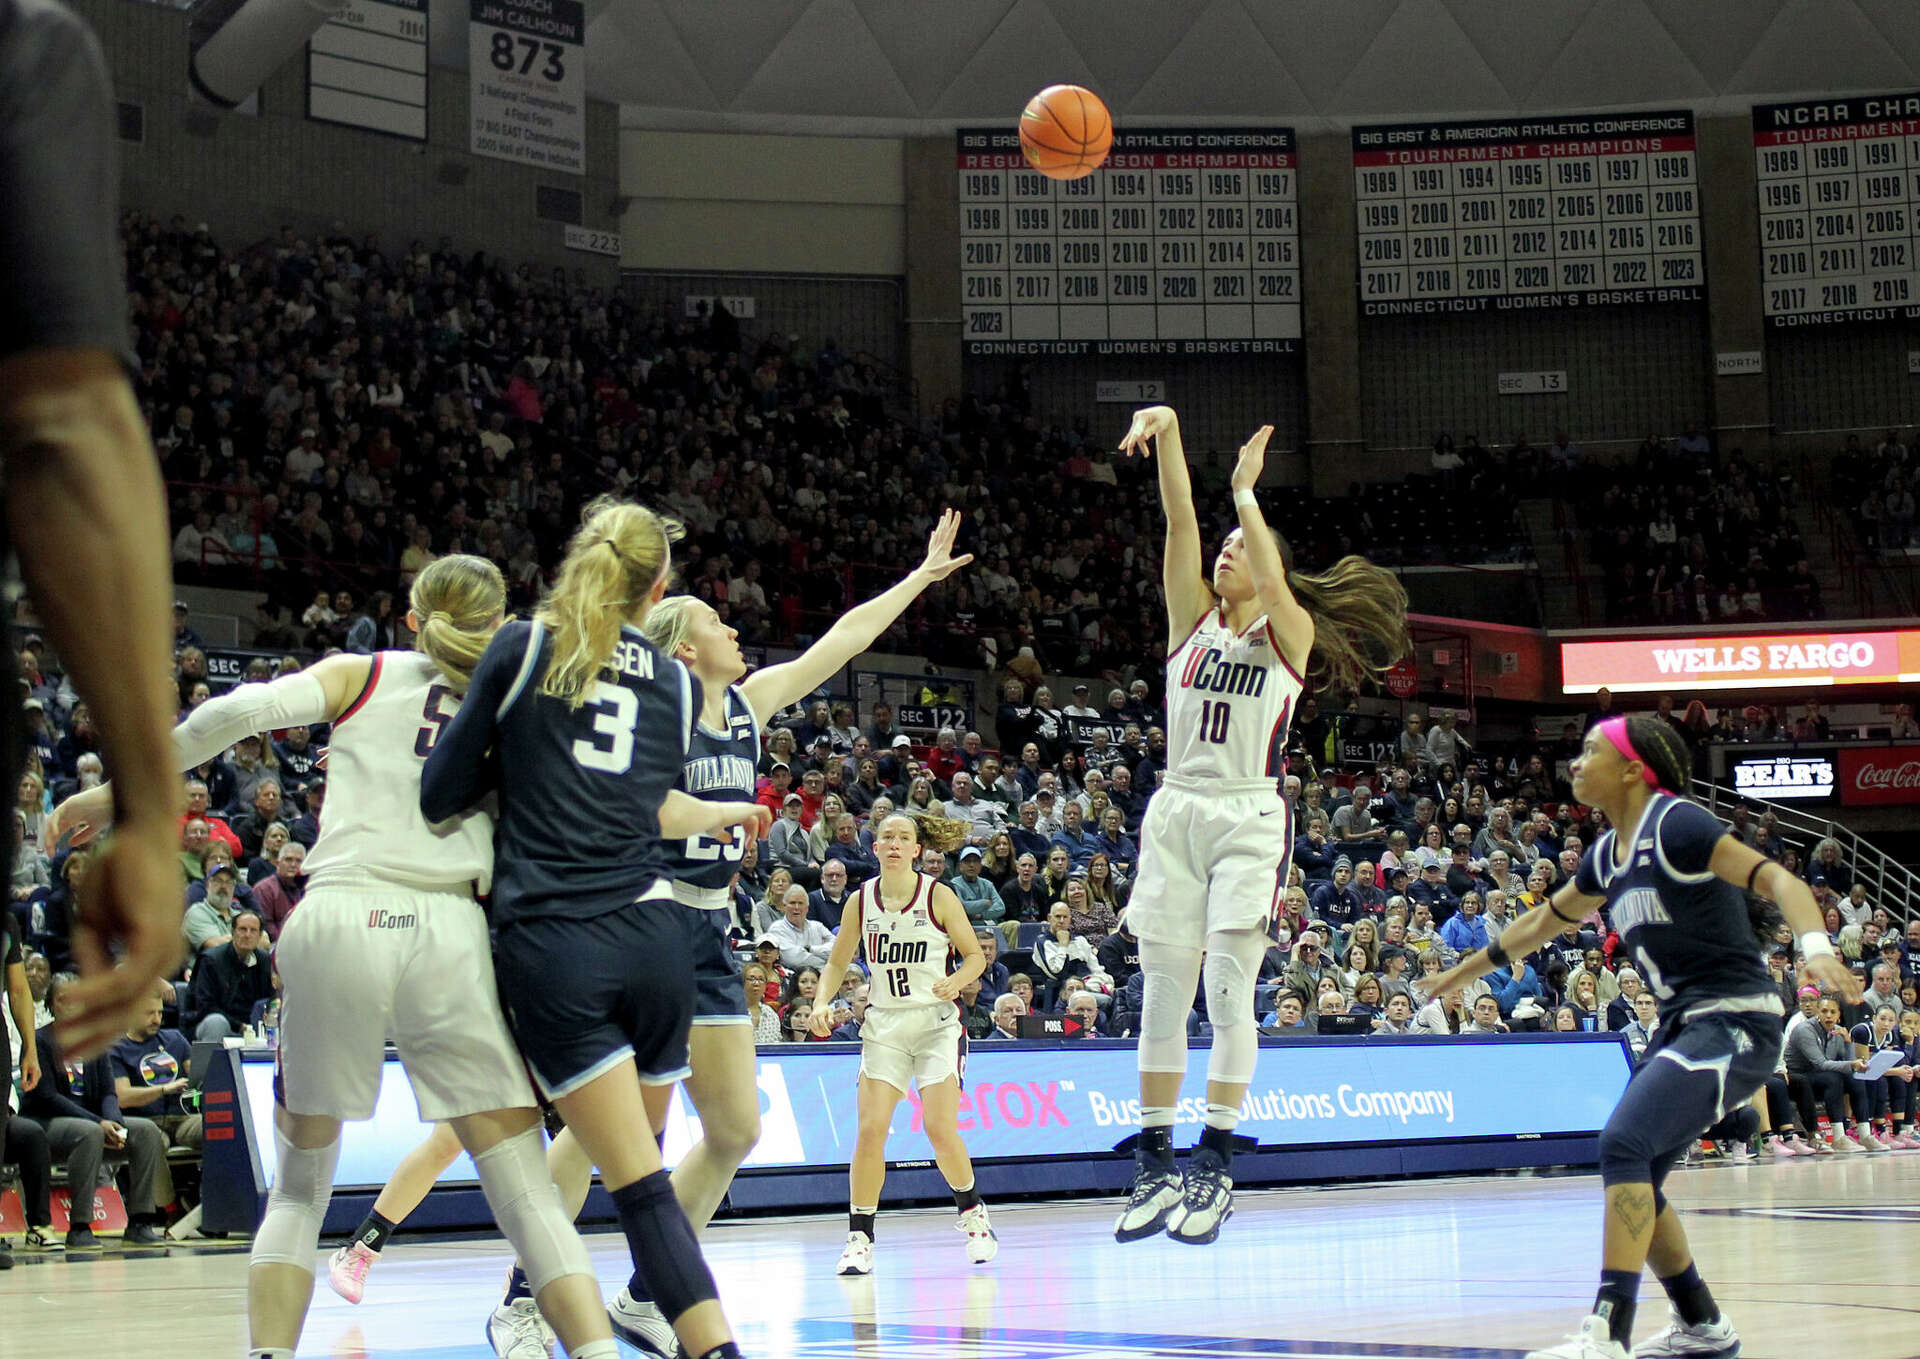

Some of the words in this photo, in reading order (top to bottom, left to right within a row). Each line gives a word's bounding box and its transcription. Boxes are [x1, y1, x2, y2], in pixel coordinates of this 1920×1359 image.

[481, 4, 504, 21] JIM
[507, 11, 576, 38] CALHOUN
[490, 31, 565, 82] 873
[1774, 105, 1849, 125] NCAA
[964, 136, 989, 147] BIG
[1126, 135, 1193, 147] ATHLETIC
[1197, 135, 1287, 147] CONFERENCE
[1360, 132, 1383, 145] BIG
[1388, 130, 1424, 143] EAST
[1431, 128, 1441, 141] &
[1446, 125, 1518, 140] AMERICAN
[1523, 122, 1590, 138] ATHLETIC
[1594, 117, 1686, 134] CONFERENCE
[1773, 121, 1918, 143] TOURNAMENT
[1167, 155, 1289, 167] CHAMPIONS
[1387, 145, 1527, 164] TOURNAMENT
[1540, 139, 1662, 157] CHAMPIONS
[1764, 151, 1799, 173] 1989
[1814, 146, 1849, 168] 1990
[1865, 143, 1897, 165] 1991
[966, 175, 1000, 196] 1989
[1015, 175, 1048, 196] 1990
[1065, 175, 1096, 196] 1991
[1112, 174, 1145, 195] 1994
[1160, 174, 1193, 195] 1995
[1208, 174, 1241, 195] 1996
[1256, 174, 1289, 195] 1997
[1362, 171, 1397, 193] 1989
[1412, 169, 1444, 191] 1991
[1459, 167, 1494, 188] 1994
[1508, 164, 1542, 186] 1995
[1557, 162, 1592, 184] 1996
[1606, 160, 1639, 182] 1997
[1654, 157, 1688, 179] 1998
[1766, 184, 1800, 206] 1996
[1816, 181, 1849, 202] 1997
[1866, 176, 1901, 198] 1998
[967, 209, 1000, 230] 1998
[1015, 209, 1049, 230] 1999
[1063, 209, 1099, 230] 2000
[1112, 209, 1146, 229] 2001
[1159, 209, 1196, 229] 2002
[1207, 208, 1244, 229] 2003
[1256, 208, 1292, 229] 2004
[1365, 205, 1398, 227] 1999
[1412, 203, 1448, 224] 2000
[1462, 200, 1497, 222] 2001
[1509, 198, 1545, 219] 2002
[1558, 196, 1594, 218] 2005
[1607, 193, 1644, 215] 2006
[1656, 191, 1693, 213] 2008
[1766, 218, 1804, 241] 2003
[1816, 214, 1854, 237] 2004
[1866, 211, 1904, 233] 2005
[590, 233, 620, 252] 223
[966, 243, 1002, 264] 2007
[1015, 243, 1051, 264] 2008
[1064, 243, 1100, 264] 2009
[1113, 242, 1148, 264] 2010
[1161, 242, 1196, 264] 2011
[1209, 242, 1244, 263] 2014
[1258, 242, 1292, 263] 2015
[1364, 238, 1401, 261] 2009
[1413, 237, 1450, 258] 2010
[1463, 234, 1498, 256] 2011
[1513, 232, 1546, 254] 2012
[1560, 229, 1597, 251] 2014
[1609, 227, 1644, 249] 2015
[1658, 224, 1693, 247] 2016
[1770, 253, 1806, 275] 2010
[1820, 249, 1855, 271] 2011
[1871, 245, 1905, 267] 2012
[967, 277, 1001, 297] 2016
[1016, 277, 1050, 297] 2017
[1064, 276, 1099, 297] 2018
[1114, 275, 1148, 296] 2019
[1163, 277, 1197, 298] 2020
[1213, 276, 1245, 297] 2021
[1259, 275, 1293, 296] 2022
[1368, 272, 1401, 294] 2017
[1417, 270, 1450, 292] 2018
[1466, 268, 1500, 290] 2019
[1515, 266, 1549, 288] 2020
[1564, 264, 1595, 285] 2021
[1613, 261, 1646, 283] 2022
[1662, 259, 1695, 281] 2023
[1366, 298, 1488, 316] CONNECTICUT
[1497, 294, 1579, 310] WOMEN'S
[1587, 289, 1702, 305] BASKETBALL
[1771, 288, 1806, 311] 2017
[1822, 285, 1857, 307] 2018
[1873, 279, 1908, 301] 2019
[970, 312, 1003, 334] 2023
[1775, 309, 1896, 326] CONNECTICUT
[971, 343, 1089, 355] CONNECTICUT
[1099, 342, 1177, 354] WOMEN'S
[1186, 341, 1294, 353] BASKETBALL
[1718, 357, 1761, 368] NORTH
[1138, 384, 1157, 398] 12
[1540, 375, 1559, 388] 13
[207, 658, 240, 674] SEC
[611, 641, 655, 680] SEN
[1653, 645, 1761, 674] WELLS
[1768, 641, 1875, 669] FARGO
[1181, 646, 1268, 697] UConn
[572, 682, 640, 776] 3
[900, 710, 924, 723] SEC
[929, 707, 967, 730] 122
[1200, 700, 1231, 744] 10
[1106, 725, 1126, 743] 12
[1345, 745, 1364, 757] SEC
[1735, 763, 1834, 787] BEAR'S
[368, 909, 416, 929] UConn
[868, 933, 928, 964] UConn
[886, 967, 911, 997] 12
[1044, 1020, 1064, 1033] POSS.
[1240, 1089, 1336, 1121] olutions
[1338, 1084, 1454, 1124] Company
